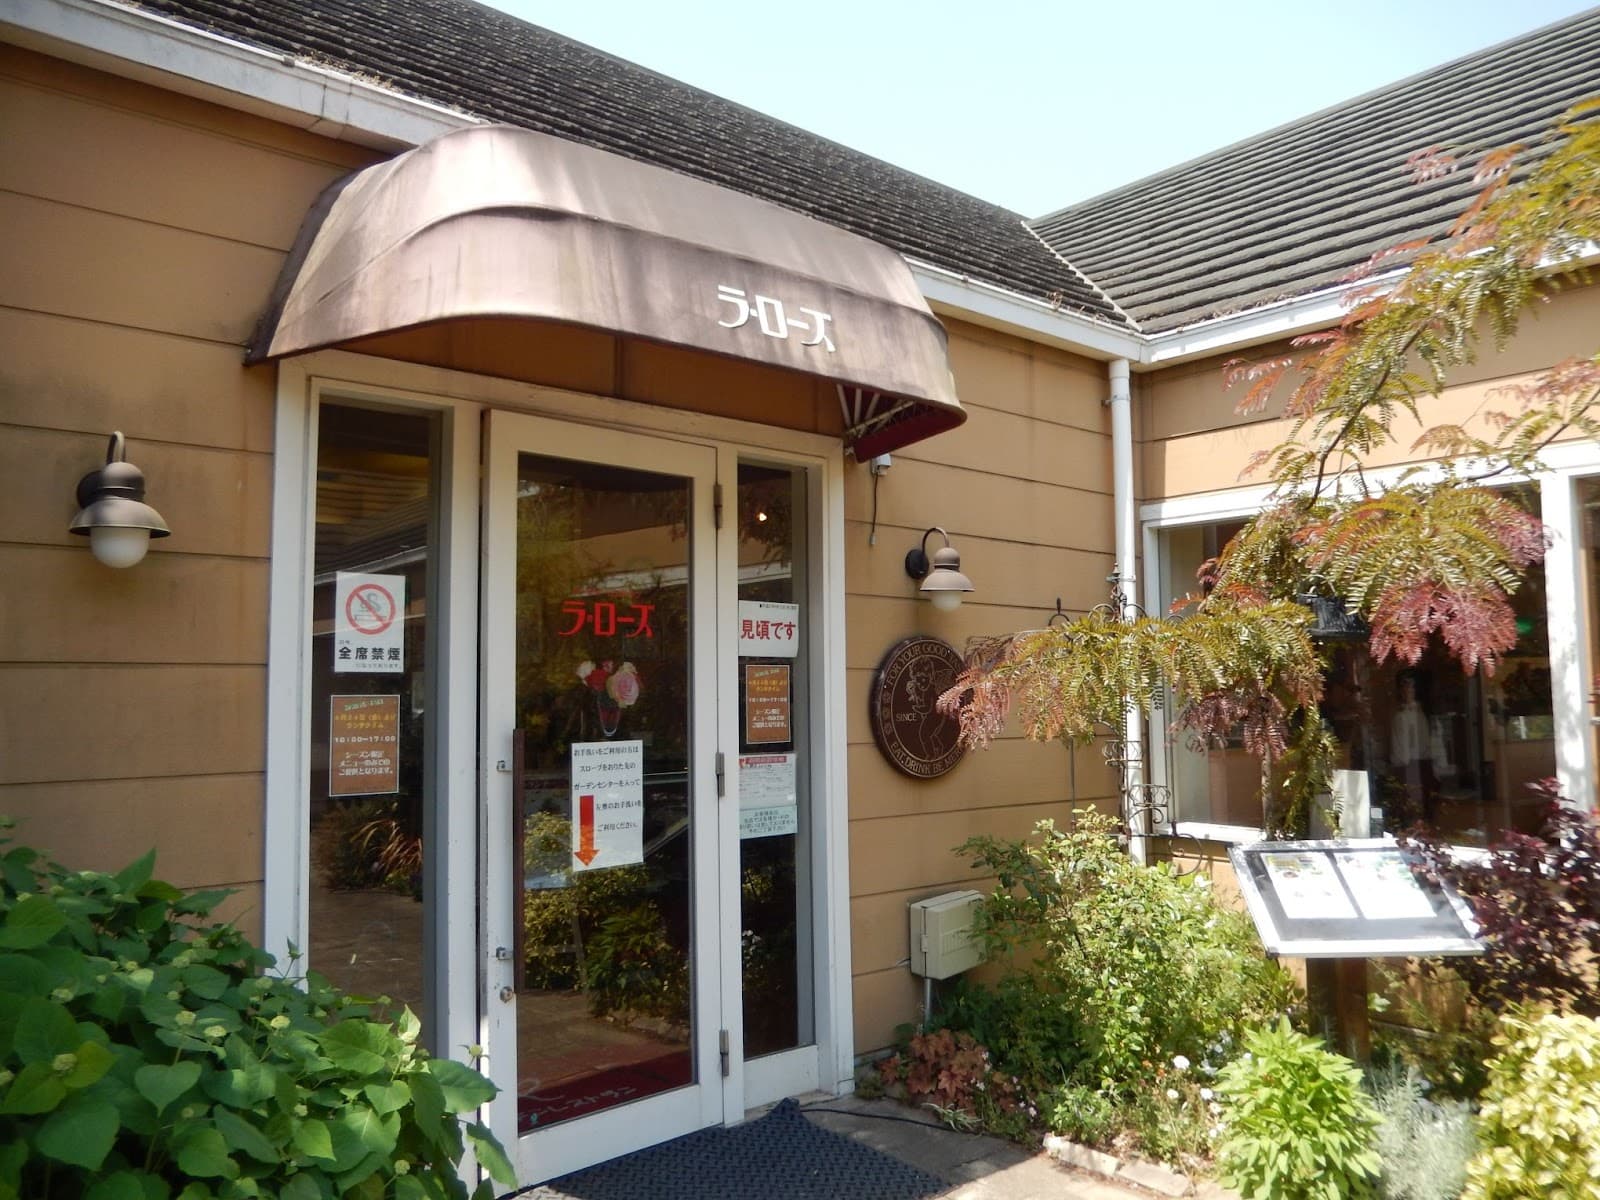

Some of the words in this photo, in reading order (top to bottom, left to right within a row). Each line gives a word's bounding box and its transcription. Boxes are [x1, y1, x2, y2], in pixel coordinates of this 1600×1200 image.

[741, 618, 796, 641] 見頃です
[338, 646, 401, 661] 全席禁煙
[886, 664, 902, 686] FOR
[899, 644, 922, 669] YOUR
[922, 643, 948, 659] GOOD
[896, 712, 918, 722] SINCE
[905, 757, 931, 774] DRINK
[933, 760, 946, 774] BE
